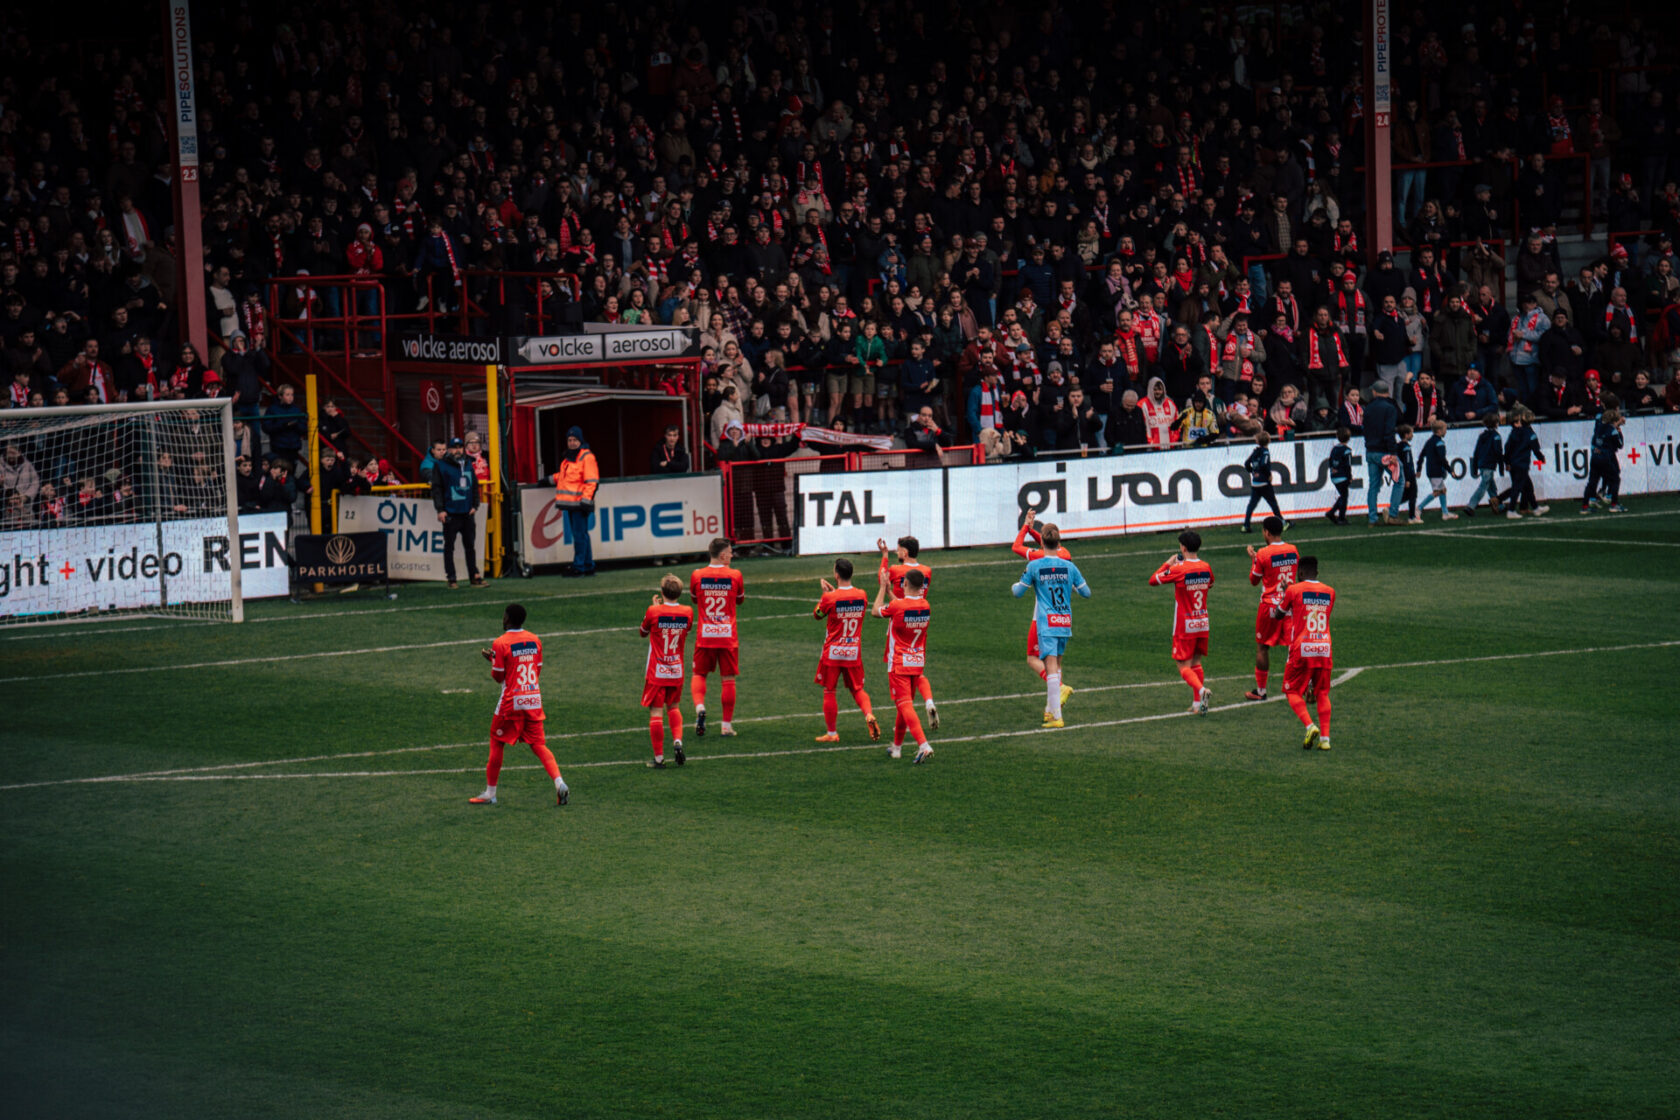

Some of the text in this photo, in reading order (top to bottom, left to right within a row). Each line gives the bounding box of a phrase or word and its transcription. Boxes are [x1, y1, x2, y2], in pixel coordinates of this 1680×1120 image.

[174, 6, 193, 123] PIPESOLUTIONS
[402, 333, 500, 362] volcke aerosol
[538, 332, 675, 358] volcke aerosol
[761, 424, 775, 436] DE
[376, 500, 418, 526] ON
[378, 528, 445, 553] TIME
[86, 547, 183, 583] video
[203, 530, 289, 573] REN
[1272, 559, 1297, 567] BRUSTOR
[299, 563, 385, 577] PARKHOTEL
[390, 563, 432, 572] LOGISTICS
[1040, 573, 1068, 581] BRUSTOR
[1185, 577, 1210, 585] BRUSTOR
[705, 597, 726, 616] 22
[1048, 587, 1064, 608] 13
[1193, 590, 1203, 610] 3
[1303, 598, 1330, 606] BRUSTOR
[842, 618, 858, 637] 19
[1307, 611, 1327, 632] 68
[662, 634, 680, 655] 14
[911, 629, 922, 648] 7
[512, 648, 538, 657] BRUSTOR
[906, 655, 924, 664] cap
[516, 662, 537, 685] 36
